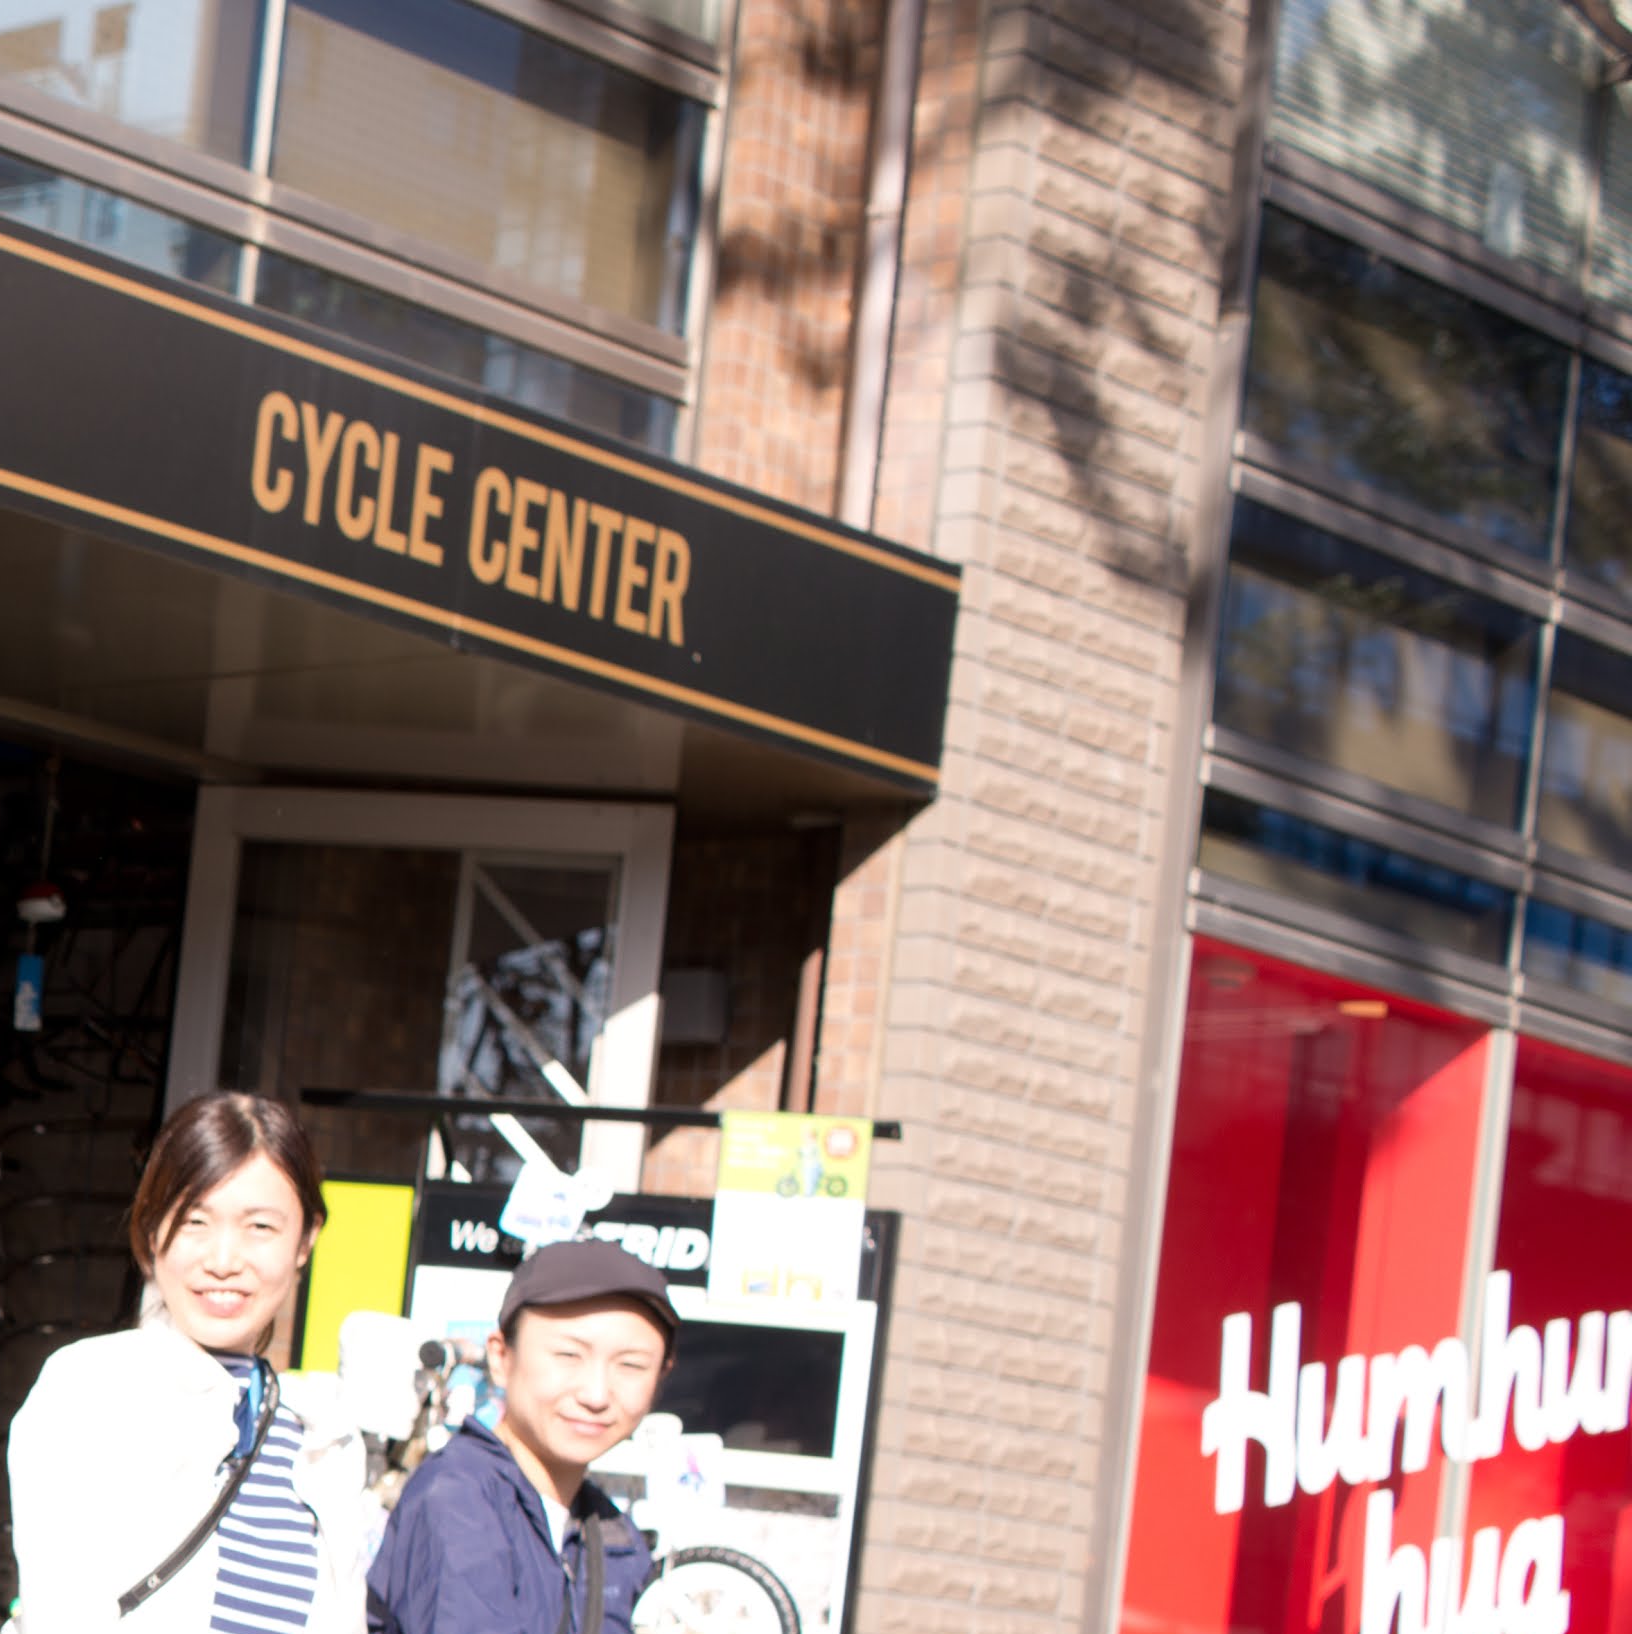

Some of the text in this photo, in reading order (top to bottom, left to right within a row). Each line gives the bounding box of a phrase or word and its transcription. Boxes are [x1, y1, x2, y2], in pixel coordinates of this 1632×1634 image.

[250, 390, 692, 647] CYCLE CENTER
[450, 1218, 500, 1254] We
[1200, 1268, 1632, 1516] Humhu
